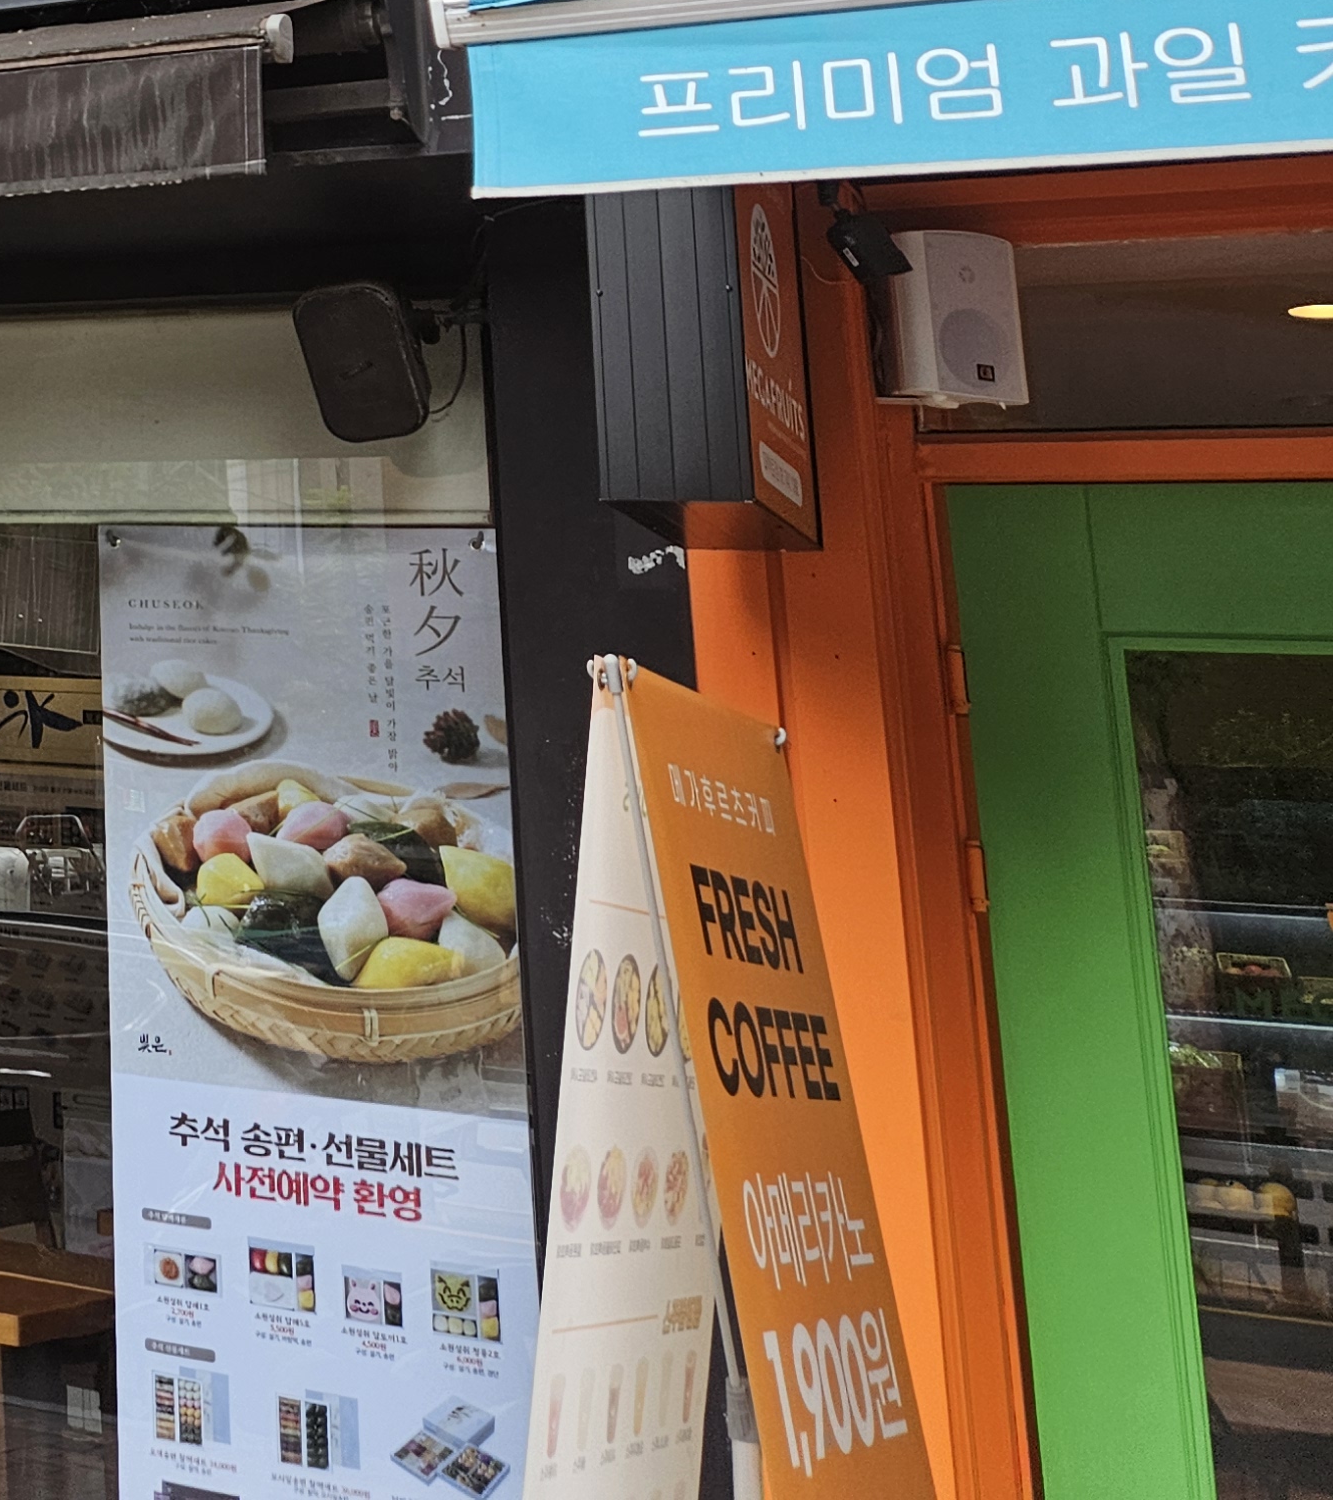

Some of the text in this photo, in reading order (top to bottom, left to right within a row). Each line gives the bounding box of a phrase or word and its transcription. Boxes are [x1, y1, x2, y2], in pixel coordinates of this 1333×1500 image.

[638, 43, 1003, 136] 프리미엄
[1050, 22, 1252, 108] 과일
[128, 599, 204, 610] CHUSEOK
[409, 548, 464, 657] 秋夕
[365, 633, 376, 657] 먹기
[367, 663, 377, 687] 좋은
[415, 665, 466, 693] 추석
[368, 692, 378, 704] 날
[382, 604, 398, 773] 포근한 가을 달빛이 가장 밝아
[668, 761, 777, 836] 메가후르츠커피
[689, 863, 804, 975] FRESH
[138, 1034, 167, 1054] 빚은
[707, 996, 841, 1102] COFFEE
[169, 1112, 230, 1151] 추석
[213, 1161, 422, 1222] 사전예약 환영
[742, 1170, 874, 1291] 아메리카노
[763, 1308, 909, 1479] 1,900원
